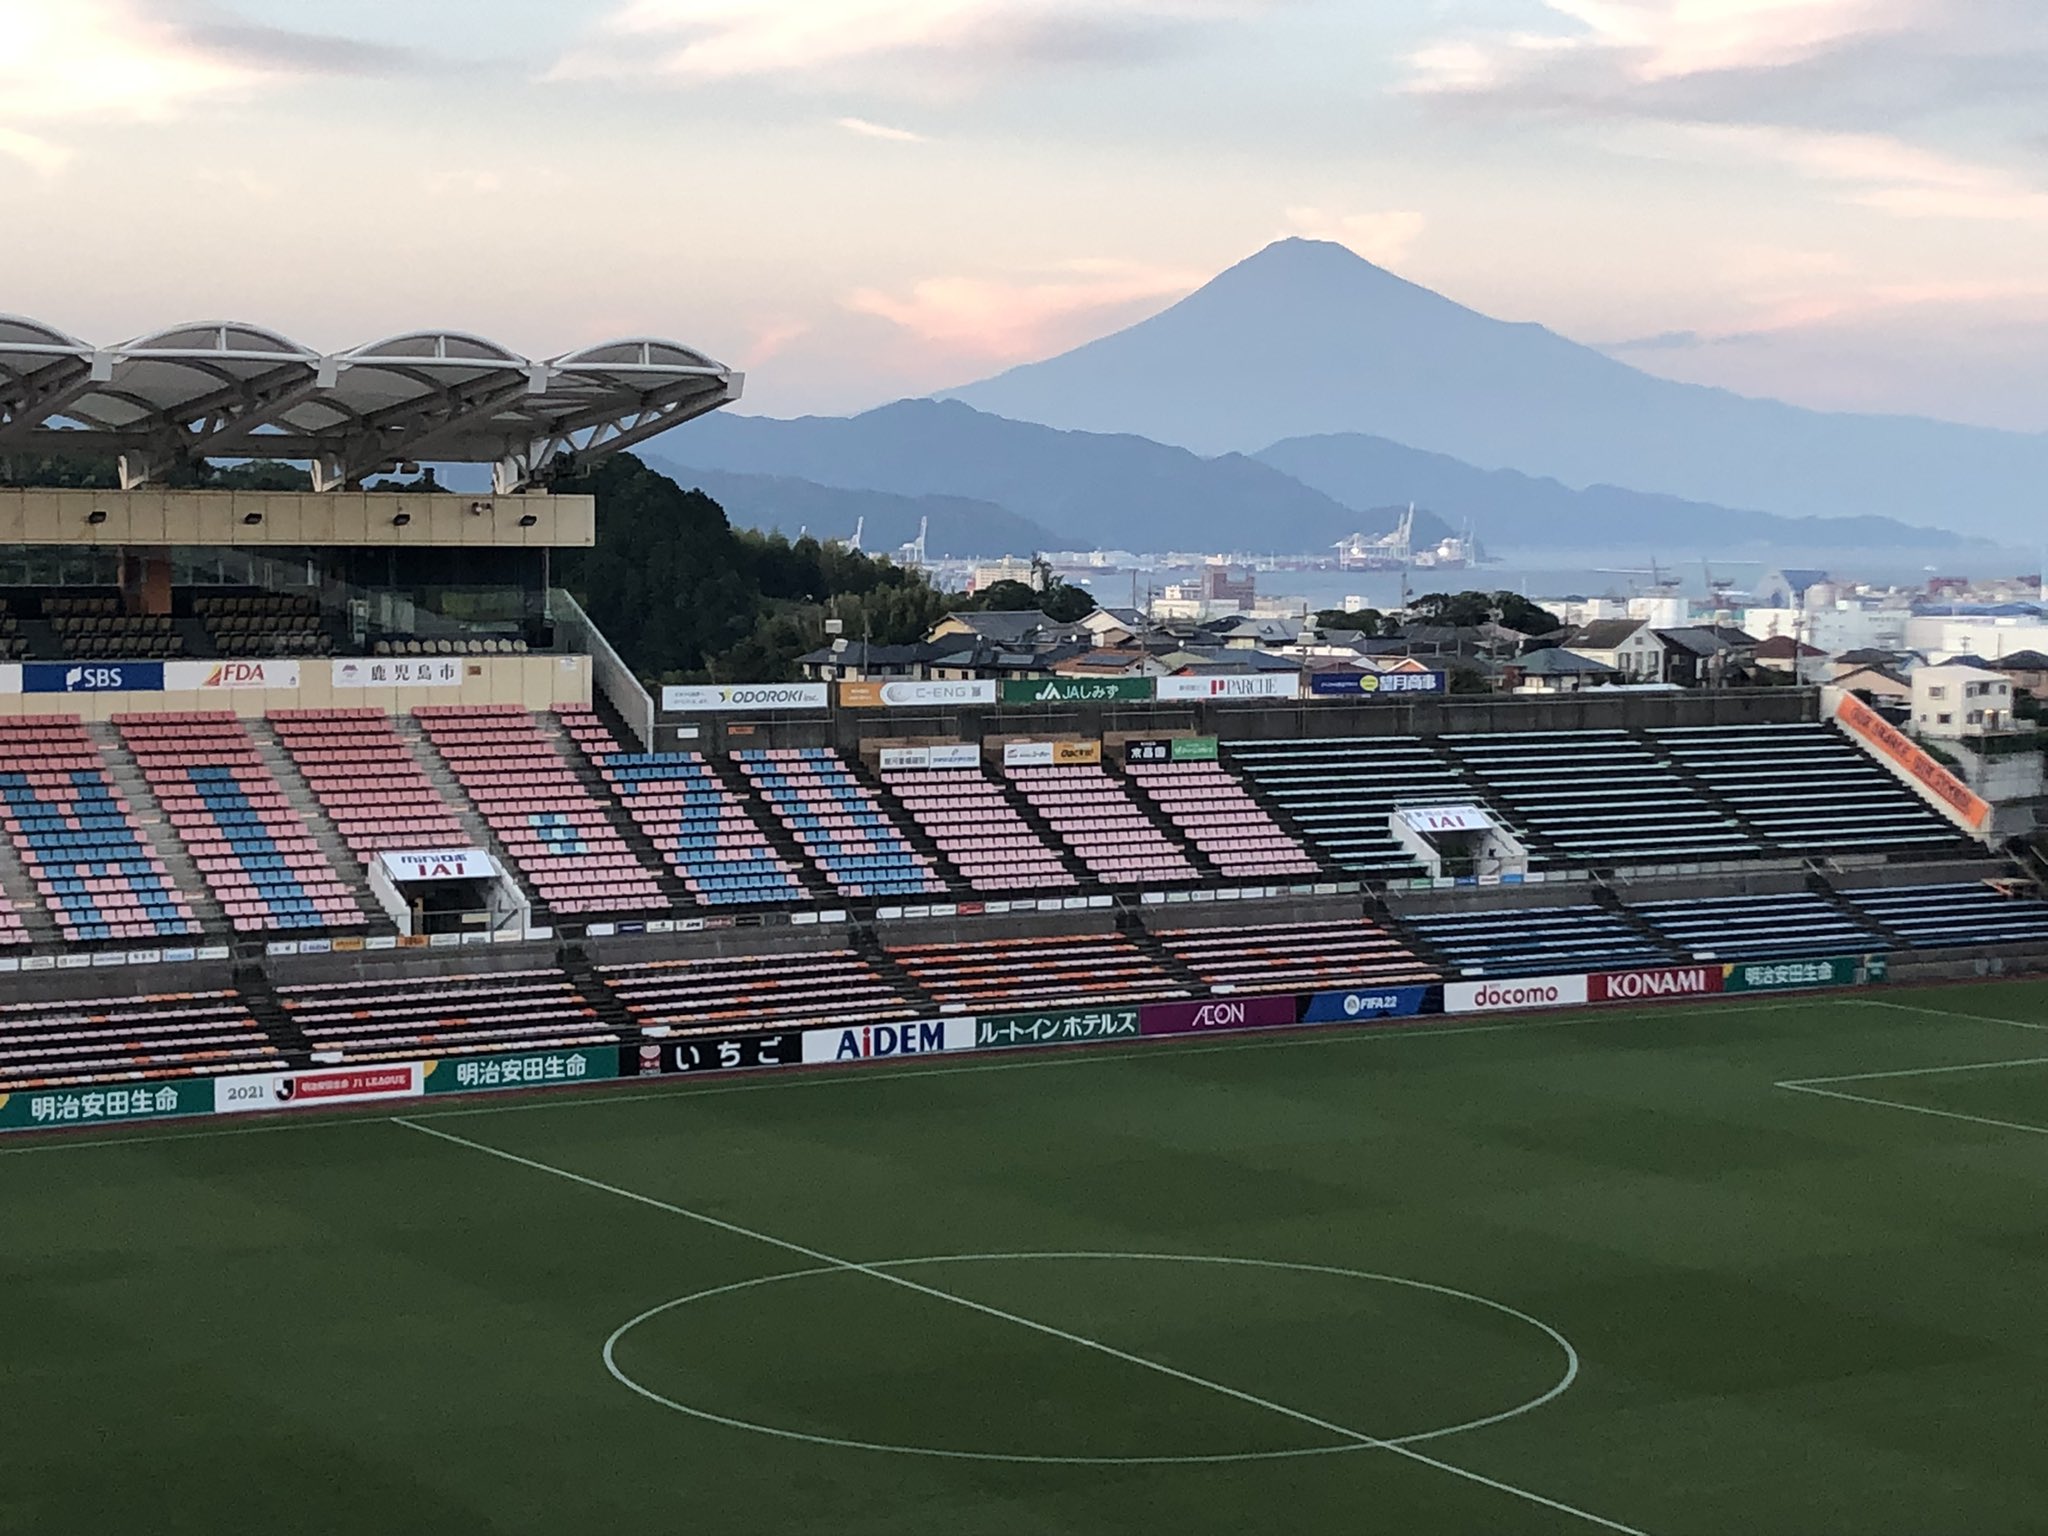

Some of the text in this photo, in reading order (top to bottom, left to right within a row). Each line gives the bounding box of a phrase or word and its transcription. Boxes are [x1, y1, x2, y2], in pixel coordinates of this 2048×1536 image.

[84, 668, 122, 687] SBS
[224, 664, 264, 680] FDA
[371, 663, 454, 681] 鹿児島市
[916, 686, 966, 698] C-ENG
[1063, 684, 1119, 699] JAしみず
[1227, 678, 1278, 695] PARCHE
[732, 690, 803, 703] ODOROKI
[1428, 815, 1475, 829] IAI
[418, 863, 464, 877] IAI
[1745, 961, 1833, 985] 明治安田生命
[1607, 969, 1705, 998] KONAMI
[1475, 984, 1558, 1006] docomo
[978, 1012, 1138, 1043] ルートインホテルズ
[675, 1036, 782, 1070] いちご
[457, 1053, 587, 1086] 明治安田生命
[365, 1074, 406, 1087] LEAGUE
[227, 1085, 264, 1100] 2021
[31, 1086, 178, 1121] 明治安田生命
